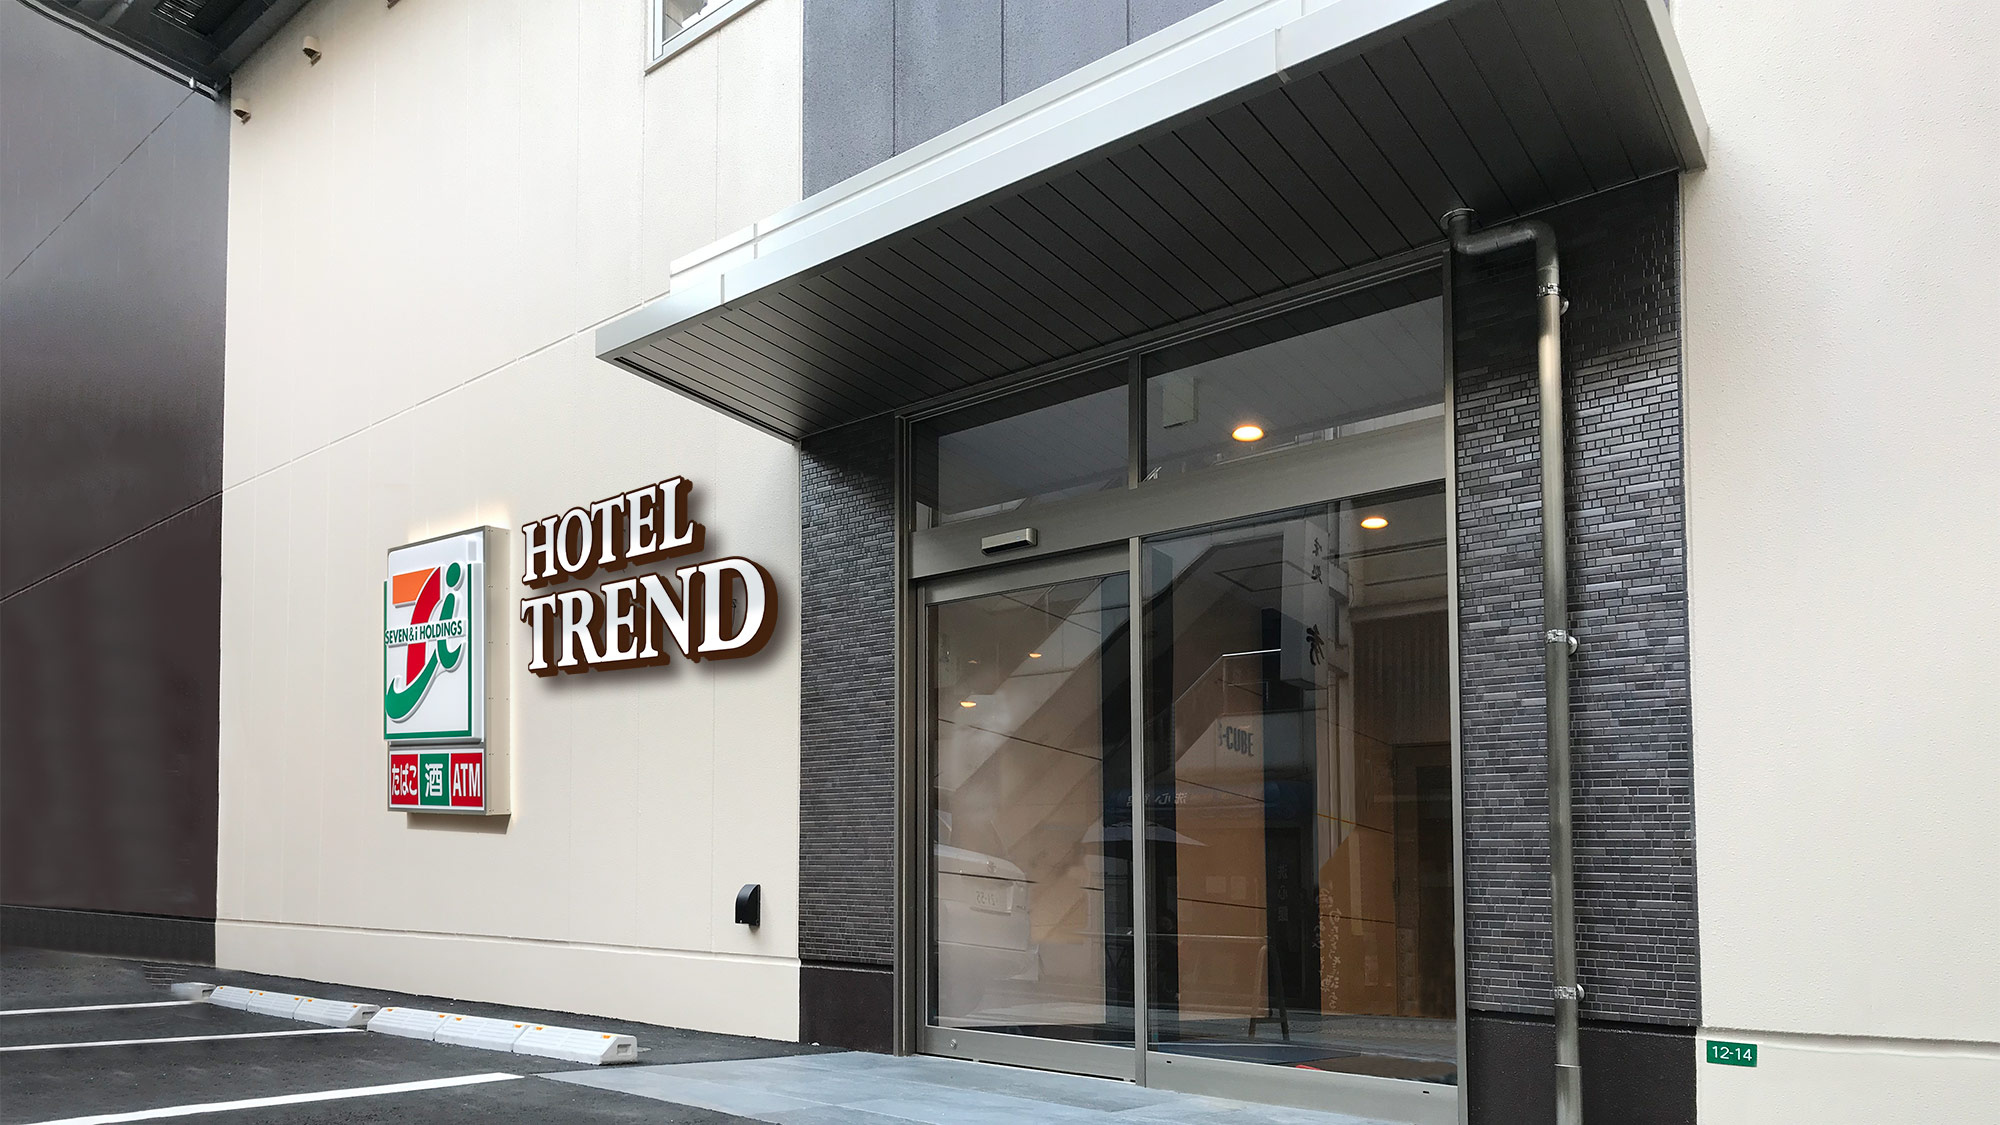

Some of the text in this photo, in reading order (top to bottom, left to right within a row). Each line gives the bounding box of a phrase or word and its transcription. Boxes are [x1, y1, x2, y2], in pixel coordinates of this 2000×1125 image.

[522, 477, 696, 585] HOTEL
[420, 620, 462, 639] HOLDINGS
[520, 556, 767, 671] TREND
[391, 762, 418, 796] たばこ
[424, 763, 444, 797] 酒
[452, 762, 481, 797] ATM
[1712, 1045, 1753, 1062] 12-14
